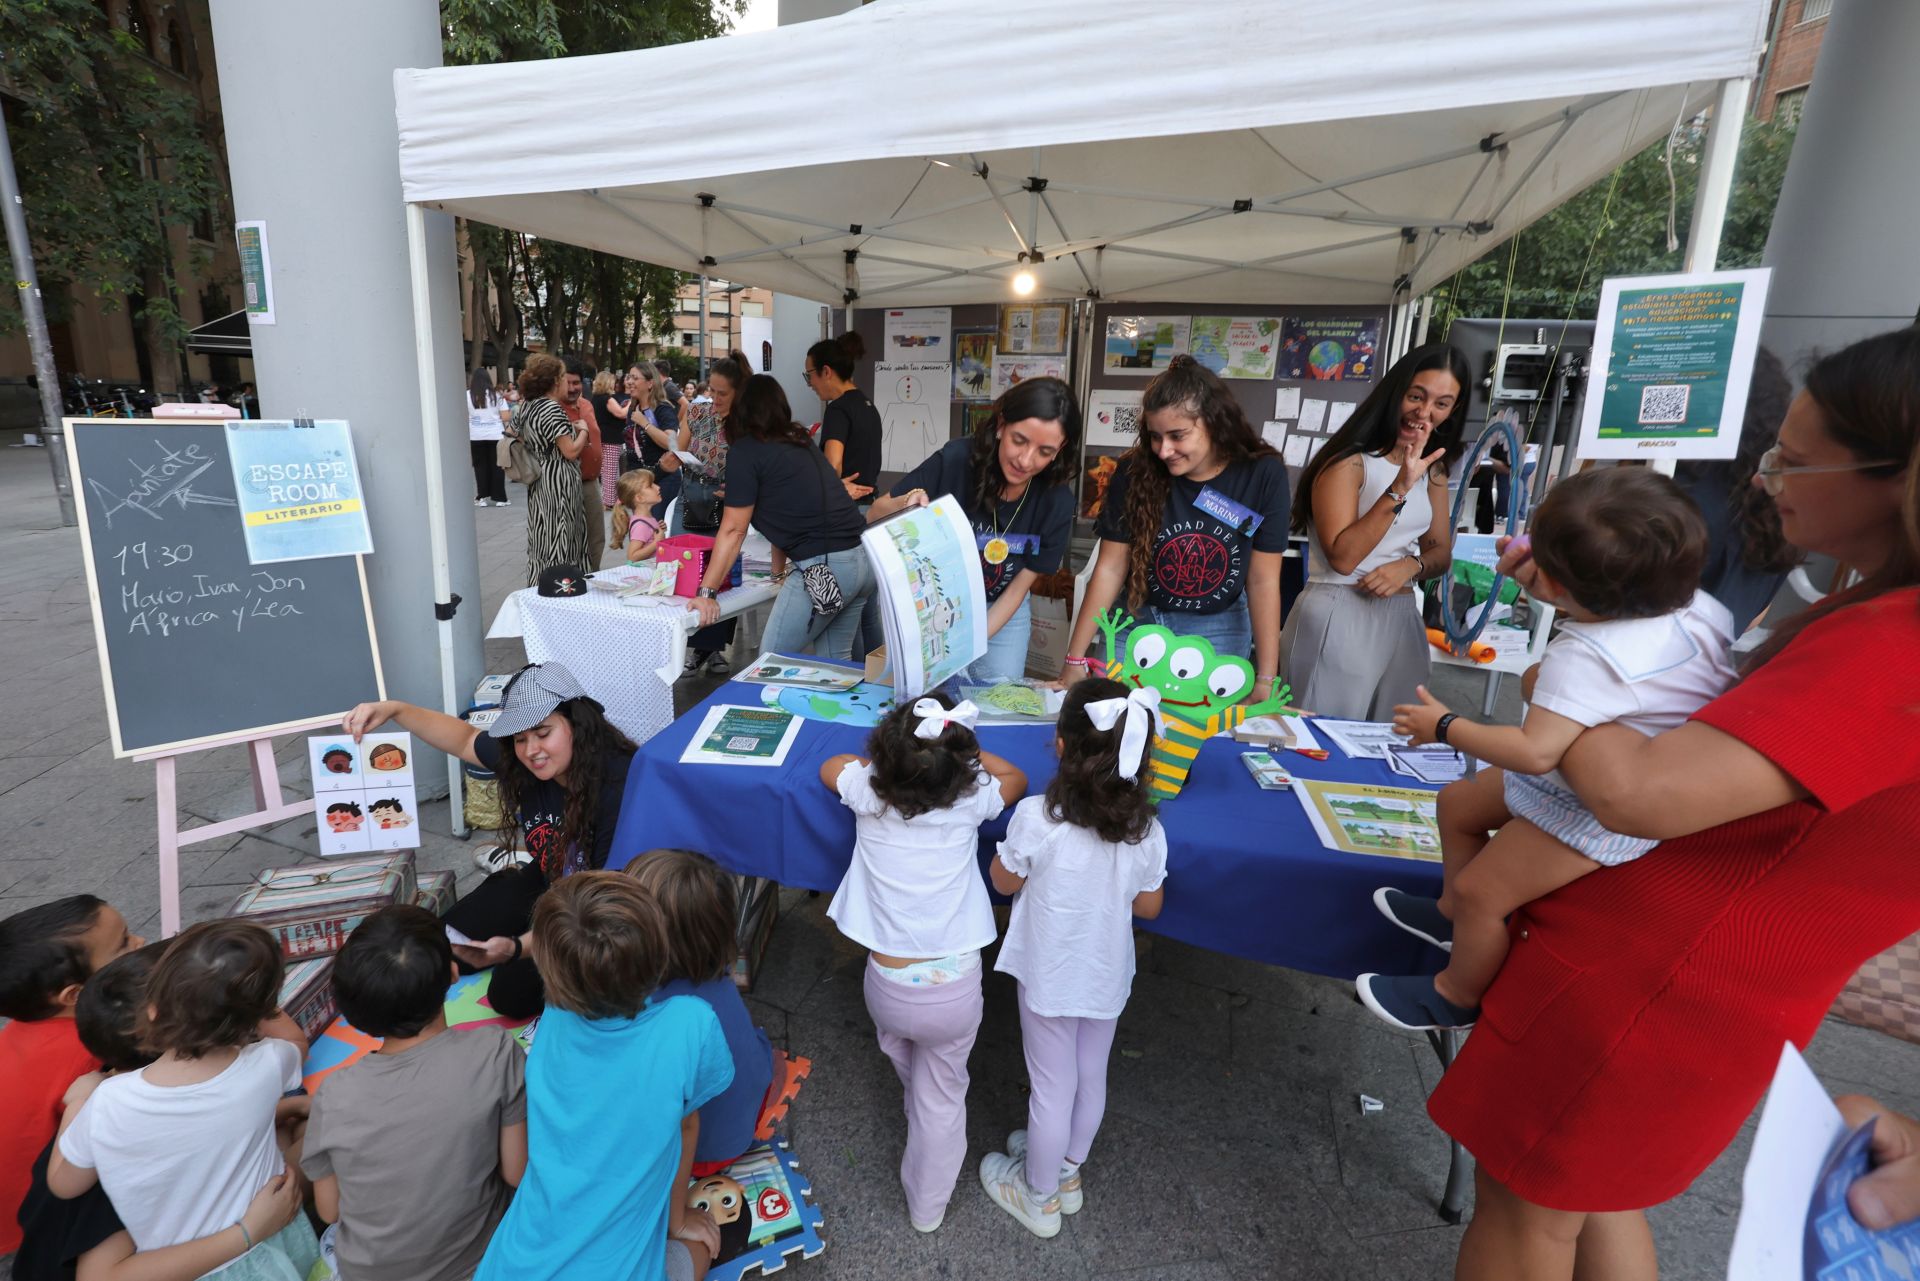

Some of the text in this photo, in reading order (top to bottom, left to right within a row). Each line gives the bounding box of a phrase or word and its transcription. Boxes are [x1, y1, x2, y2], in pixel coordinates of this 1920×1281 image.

[1301, 320, 1363, 329] LOS GUARDIANES
[1306, 329, 1356, 337] DEL PLANETA
[248, 461, 349, 483] ESCAPE
[268, 483, 340, 503] ROOM
[265, 503, 343, 521] LITERARIO
[1203, 499, 1241, 526] MARINA
[1213, 525, 1234, 543] DE
[1212, 544, 1241, 601] MURCIA
[121, 580, 192, 614] Mario,
[250, 570, 306, 593] Jon
[1167, 596, 1203, 609] 1272
[231, 606, 245, 633] y
[250, 597, 305, 618] Lea
